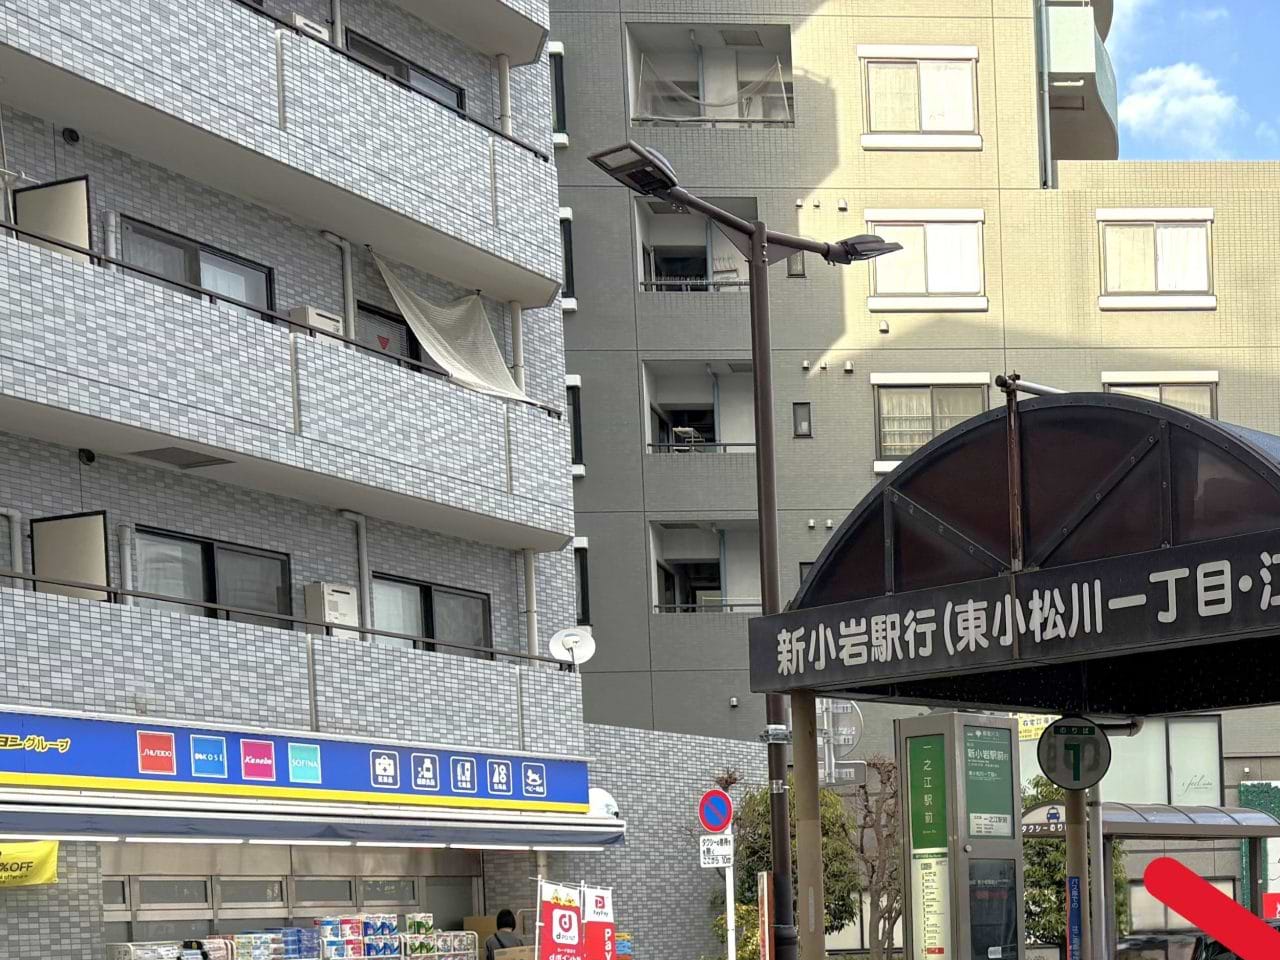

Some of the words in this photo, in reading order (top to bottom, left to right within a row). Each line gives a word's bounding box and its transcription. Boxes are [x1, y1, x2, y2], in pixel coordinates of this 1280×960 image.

[244, 756, 272, 765] Kanebo
[292, 758, 319, 767] SOFINA
[1064, 743, 1080, 781] 1
[922, 744, 933, 823] 一之江駅前
[1021, 824, 1066, 833] タクシーのり
